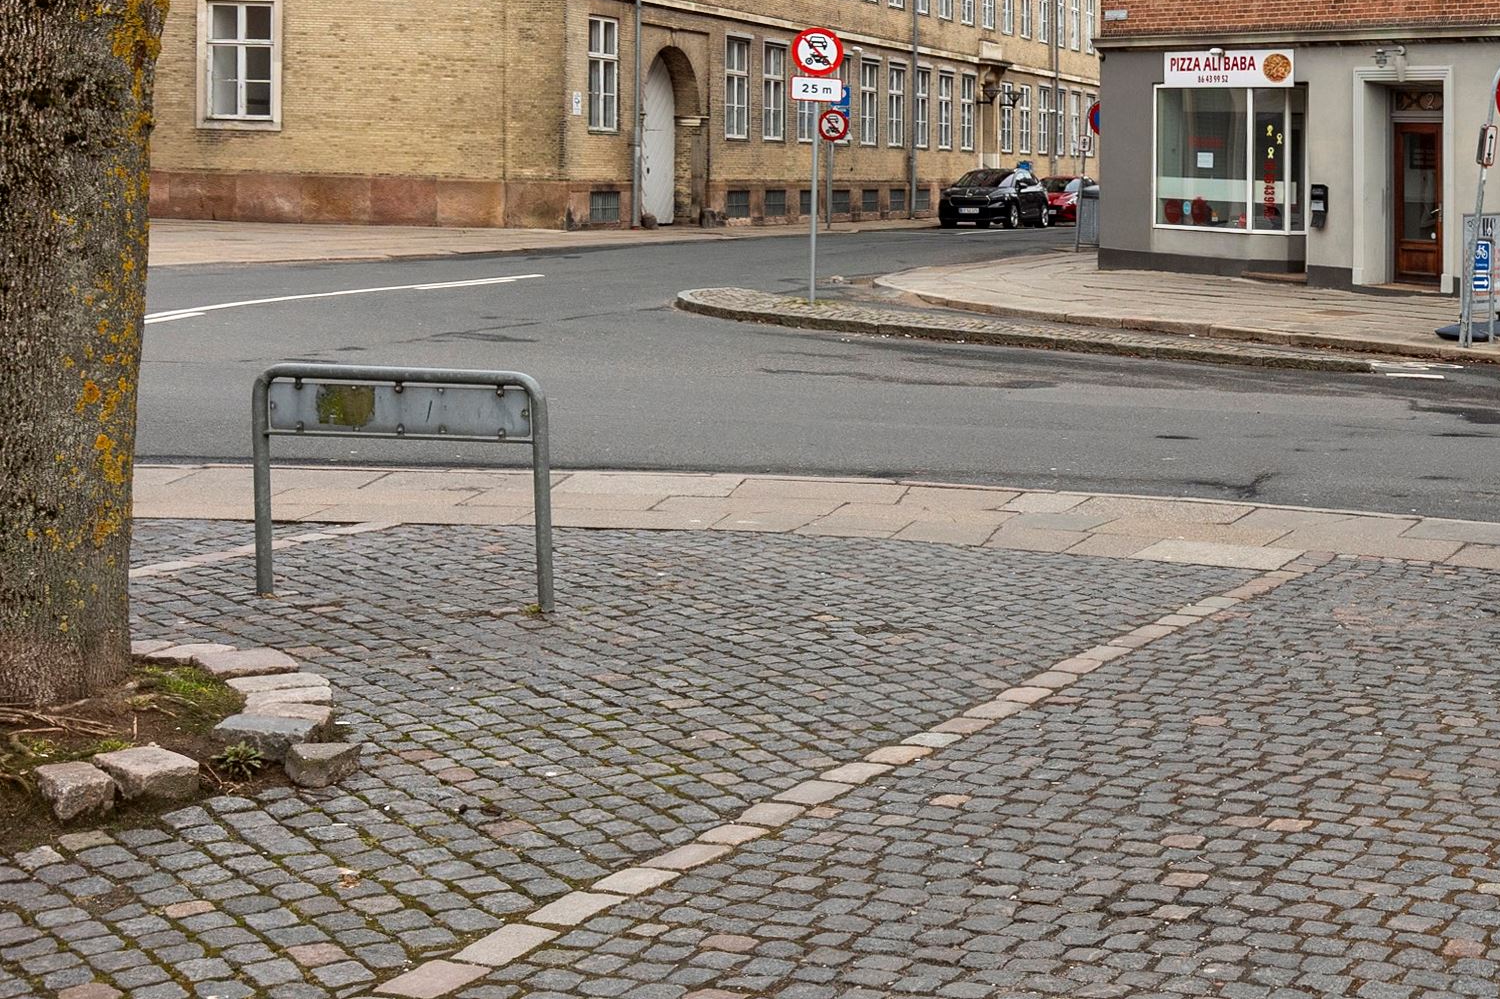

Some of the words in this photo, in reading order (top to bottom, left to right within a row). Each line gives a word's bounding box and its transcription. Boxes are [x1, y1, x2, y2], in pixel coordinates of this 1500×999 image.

[1170, 57, 1201, 72] PIZZA
[1203, 56, 1221, 71] ALI
[1223, 55, 1256, 71] BABA
[1206, 75, 1213, 83] 43
[1221, 74, 1229, 83] 52
[802, 83, 819, 94] 25
[1425, 93, 1435, 110] 2
